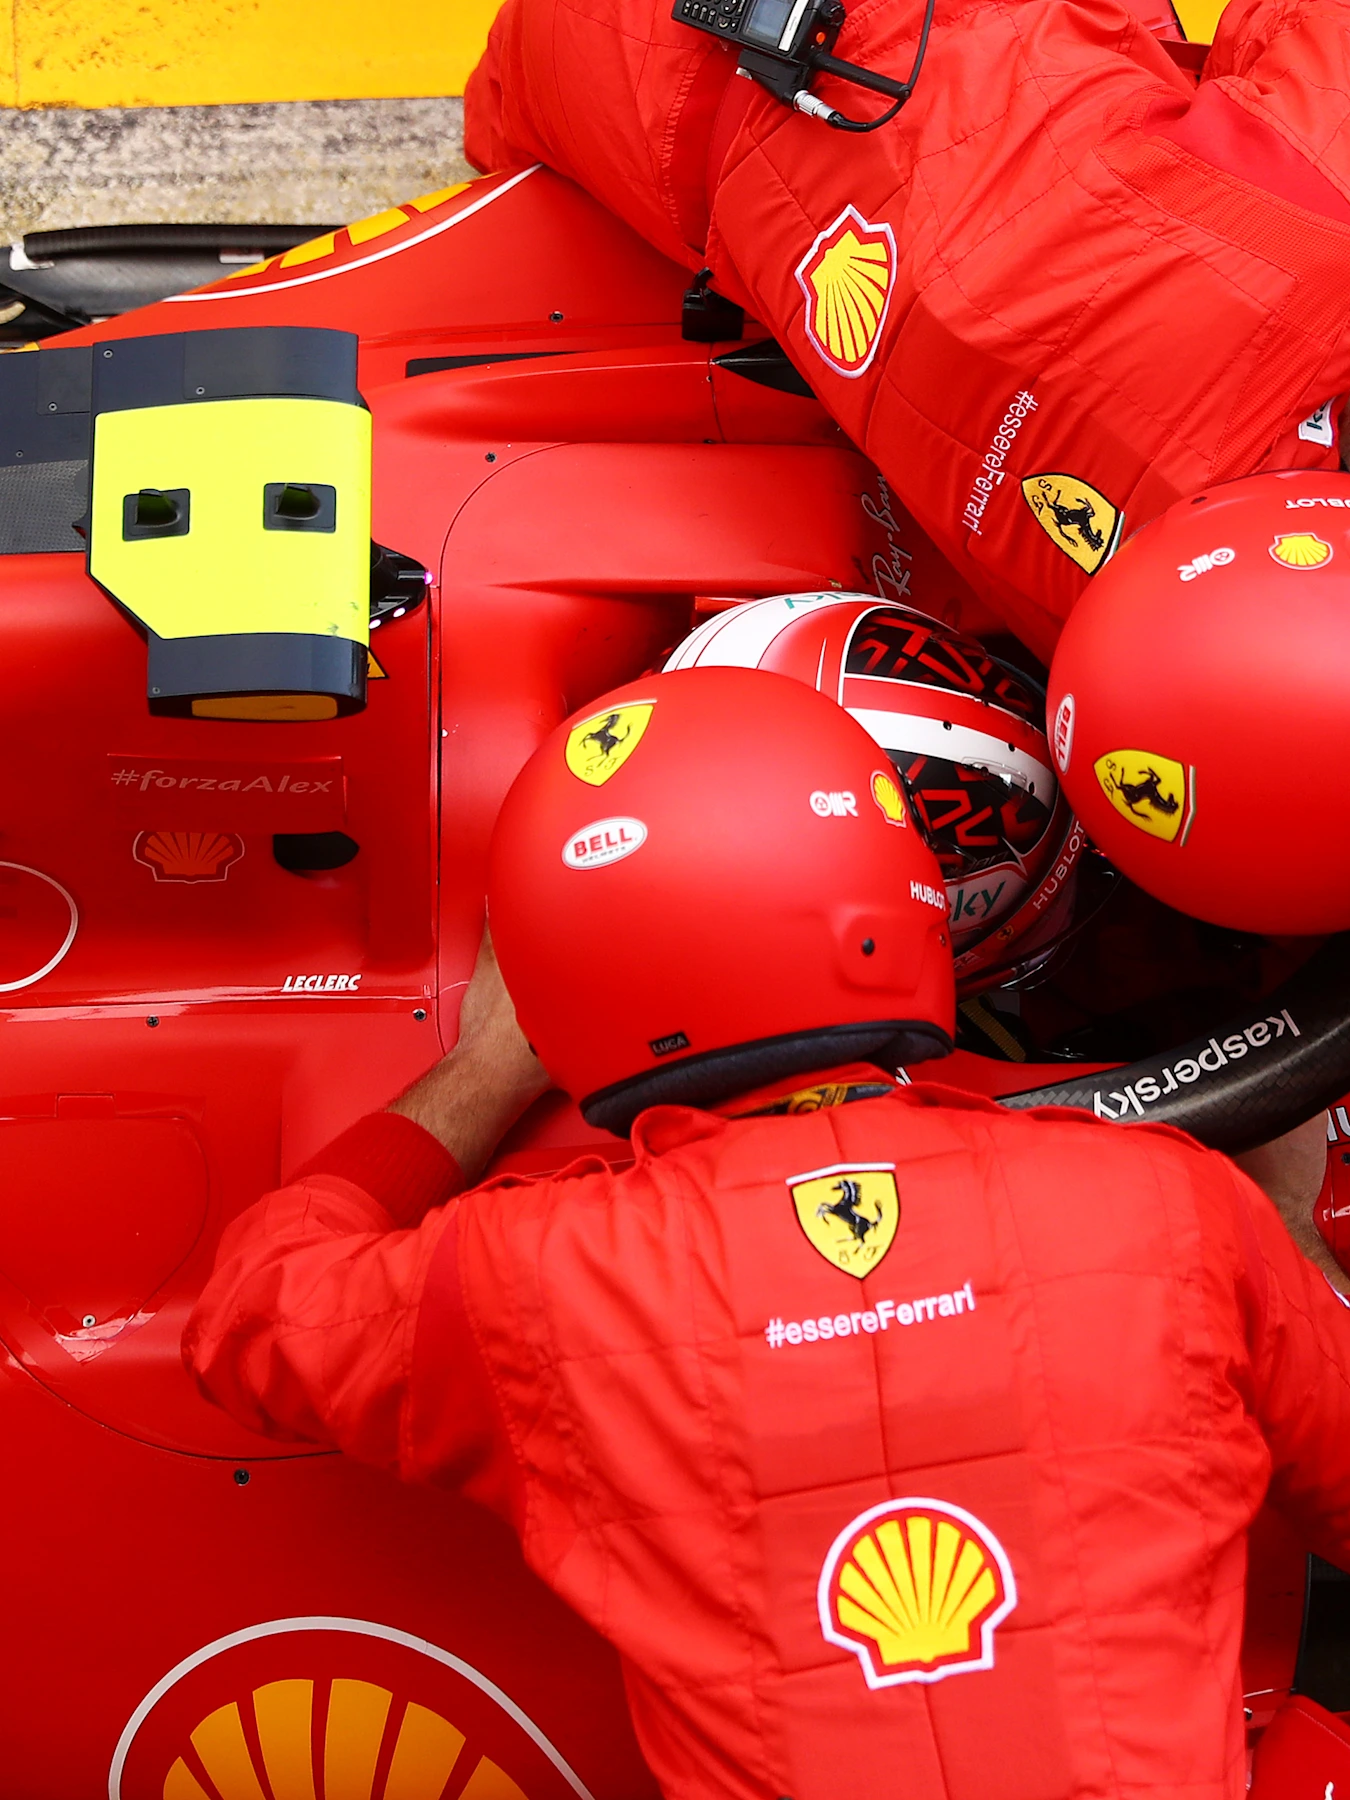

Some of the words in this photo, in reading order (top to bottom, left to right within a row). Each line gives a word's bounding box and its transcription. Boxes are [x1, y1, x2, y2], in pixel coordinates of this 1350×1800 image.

[962, 390, 1039, 536] #essereFerrari
[1055, 705, 1072, 761] BELL
[110, 769, 333, 793] #forzaAlex
[573, 828, 632, 860] BELL
[1033, 821, 1085, 910] HUBLOT
[910, 880, 947, 912] HUBLOT
[281, 974, 362, 992] LECLERC
[1093, 1008, 1301, 1120] kaspersky
[765, 1279, 976, 1349] #essereFerrari
